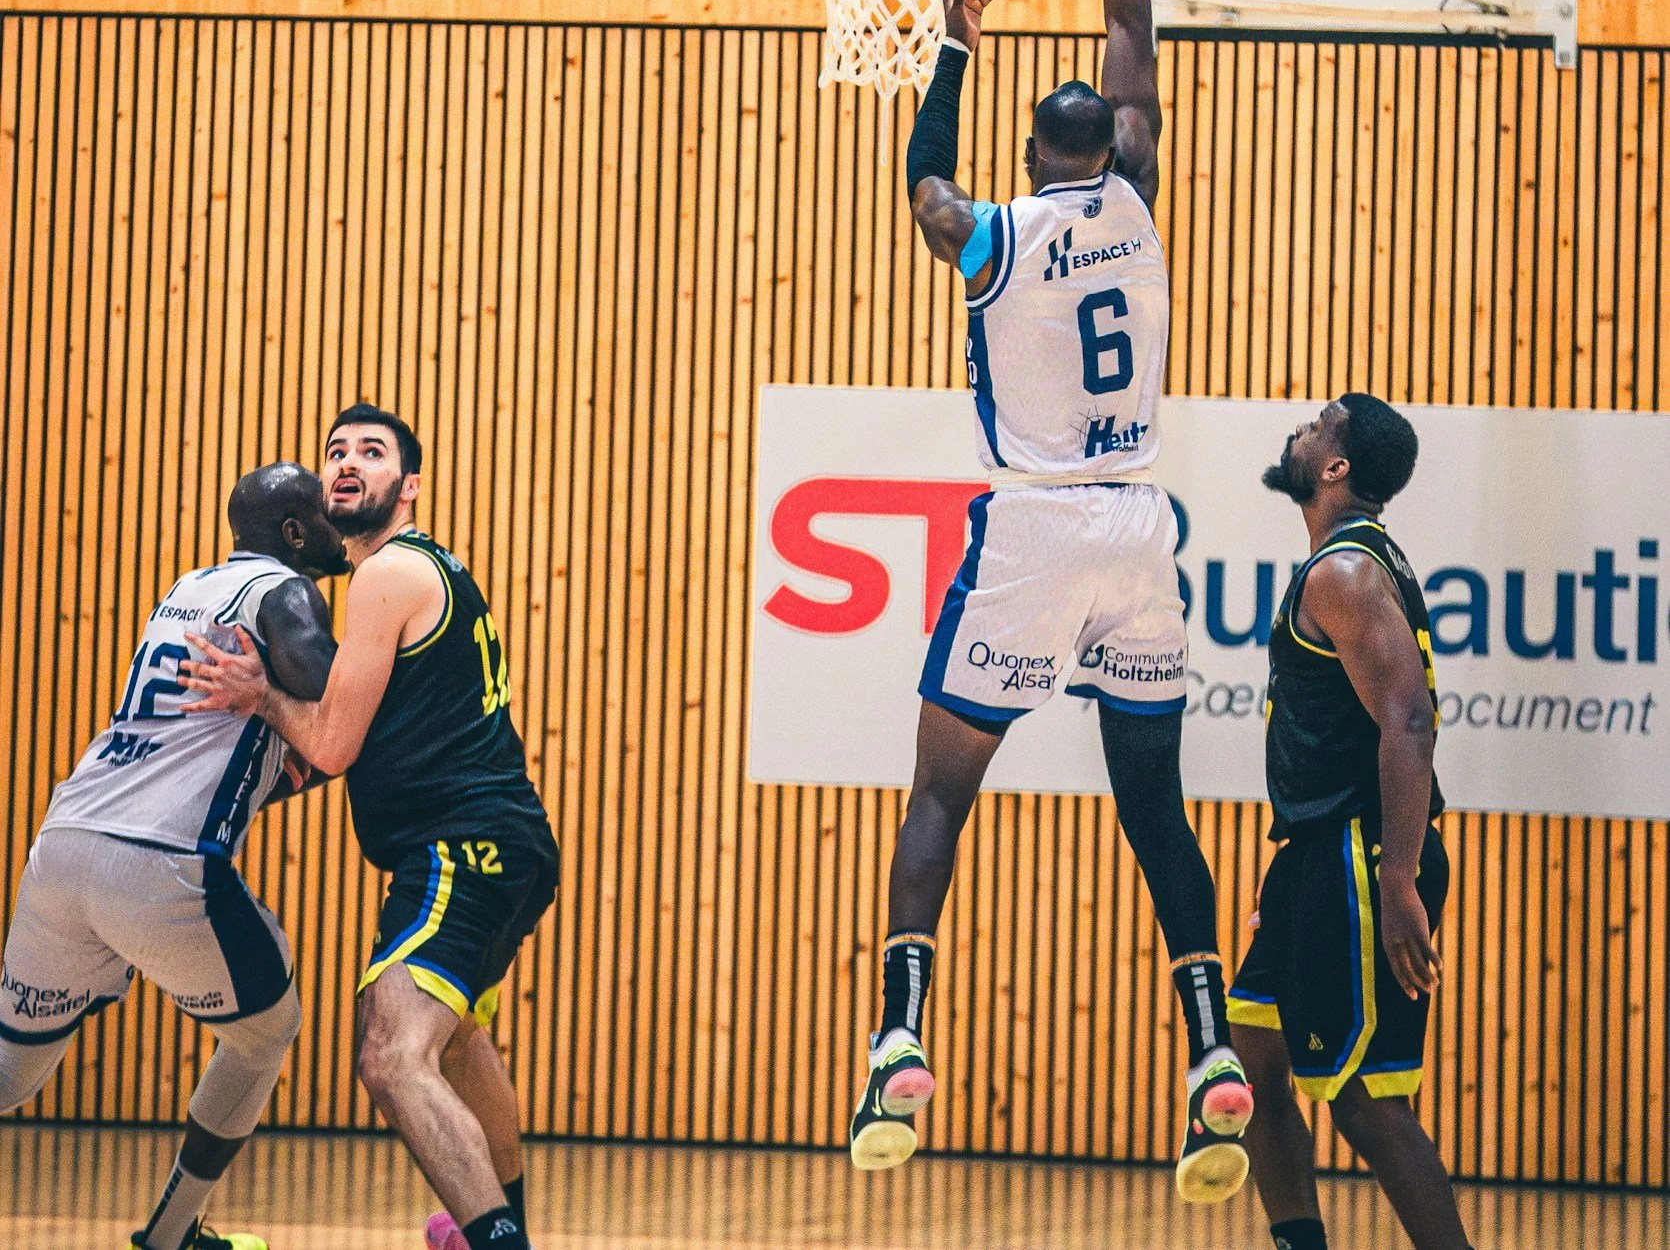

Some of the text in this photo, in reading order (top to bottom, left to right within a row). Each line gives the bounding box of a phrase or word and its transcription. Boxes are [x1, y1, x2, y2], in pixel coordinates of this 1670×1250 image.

[1072, 242, 1131, 270] ESPACE
[1077, 287, 1133, 395] 6
[967, 641, 1055, 671] Quonex
[1105, 646, 1174, 665] Commune
[1104, 660, 1184, 682] Holtzheim
[461, 840, 503, 876] 12
